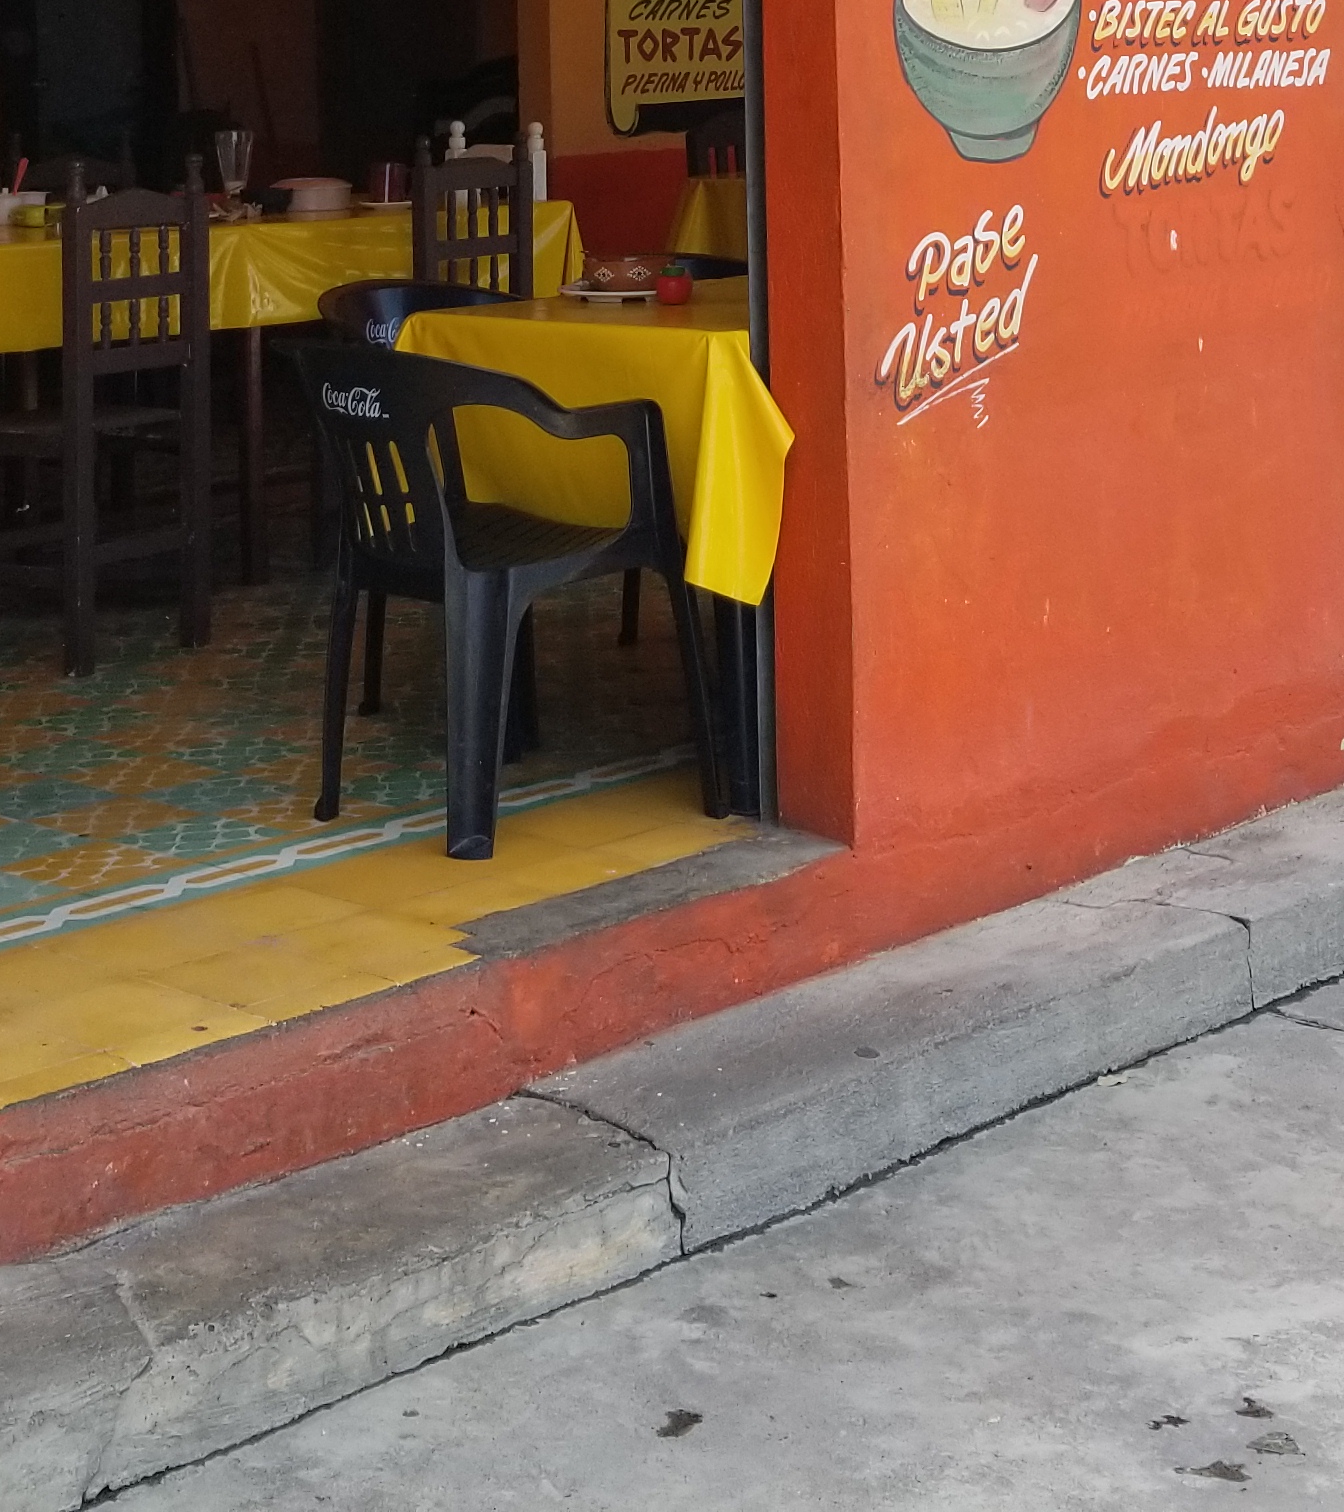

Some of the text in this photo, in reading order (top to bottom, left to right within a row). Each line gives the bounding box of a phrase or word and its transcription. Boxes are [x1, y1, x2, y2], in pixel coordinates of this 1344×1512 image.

[617, 25, 743, 65] TORTAS
[1092, 0, 1197, 51] BISTEC
[1197, 0, 1231, 44] AL
[693, 71, 704, 92] Y
[1086, 47, 1331, 100] CARNES MILANESA
[1102, 106, 1285, 196] Mondongo
[906, 203, 1026, 314] Pase
[875, 254, 1039, 412] Usted
